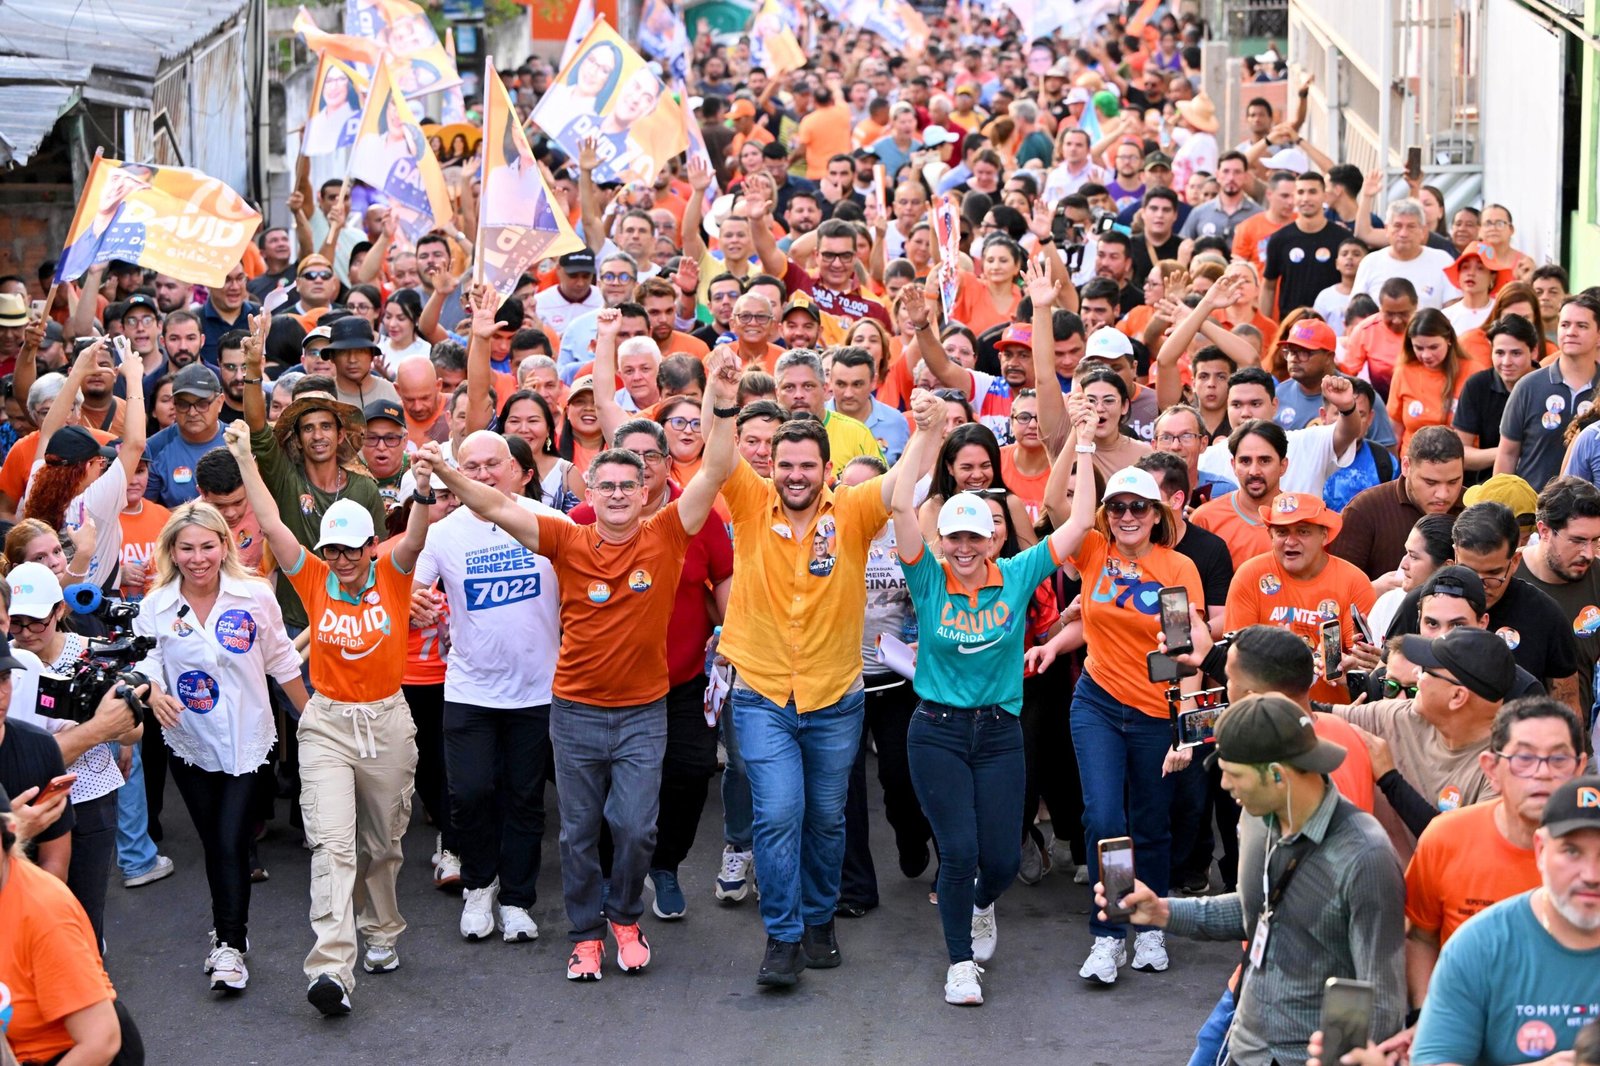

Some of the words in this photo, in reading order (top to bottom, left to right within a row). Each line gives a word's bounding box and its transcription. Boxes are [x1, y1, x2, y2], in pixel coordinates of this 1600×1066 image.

[117, 198, 246, 248] DAVID
[838, 296, 869, 314] 70.000
[1128, 419, 1155, 439] id
[465, 546, 534, 566] CORONEL
[466, 556, 536, 575] MENEZES
[473, 576, 537, 606] 7022
[219, 620, 235, 628] Cris
[318, 605, 388, 638] DAVID
[317, 633, 365, 648] ALMEIDA
[936, 625, 986, 643] ALMEIDA
[223, 636, 250, 652] 7007
[178, 683, 192, 691] Cris
[187, 699, 214, 711] 7007
[1515, 1004, 1571, 1017] TOMMY
